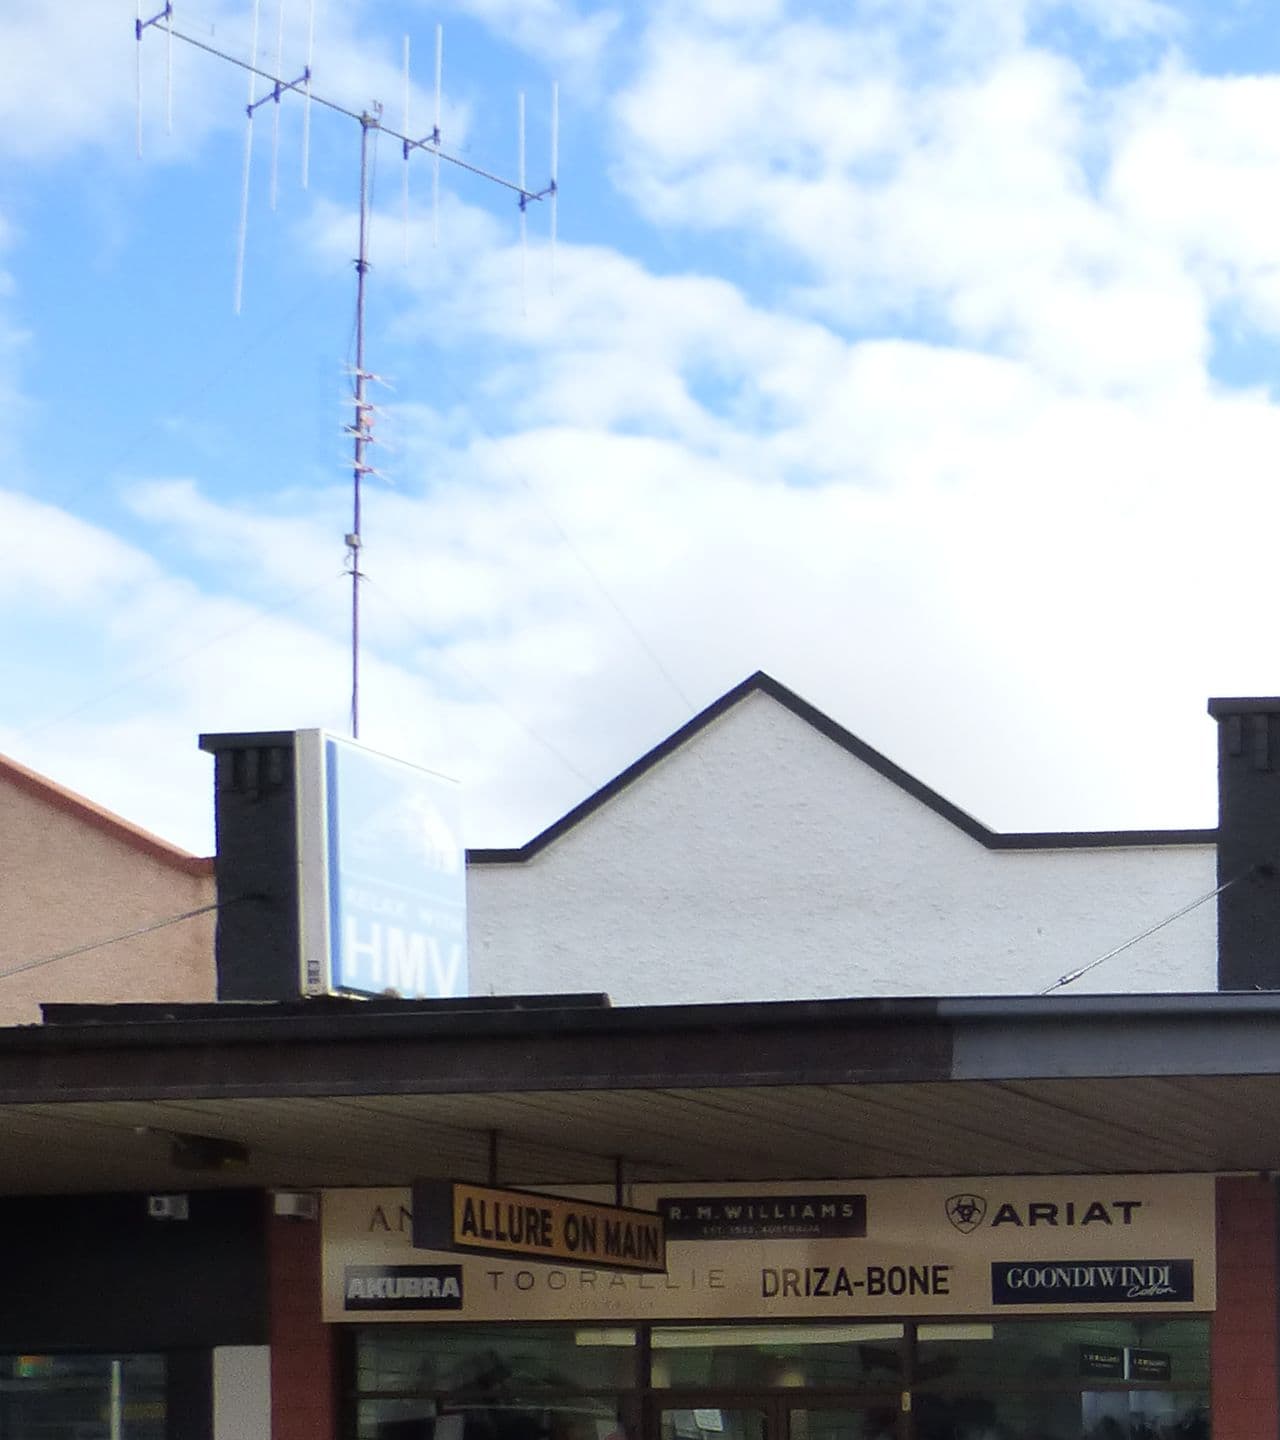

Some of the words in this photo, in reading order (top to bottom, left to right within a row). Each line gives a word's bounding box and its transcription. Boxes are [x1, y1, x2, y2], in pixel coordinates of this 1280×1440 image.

[346, 916, 462, 995] HMV
[992, 1201, 1143, 1227] ARIAT
[462, 1197, 552, 1247] ALLURE
[563, 1212, 598, 1254] ON
[604, 1223, 658, 1263] MAIN
[347, 1277, 460, 1299] AKUBRA
[762, 1265, 950, 1298] DRIZA-BONE
[1006, 1265, 1170, 1289] GOONDIWINDI
